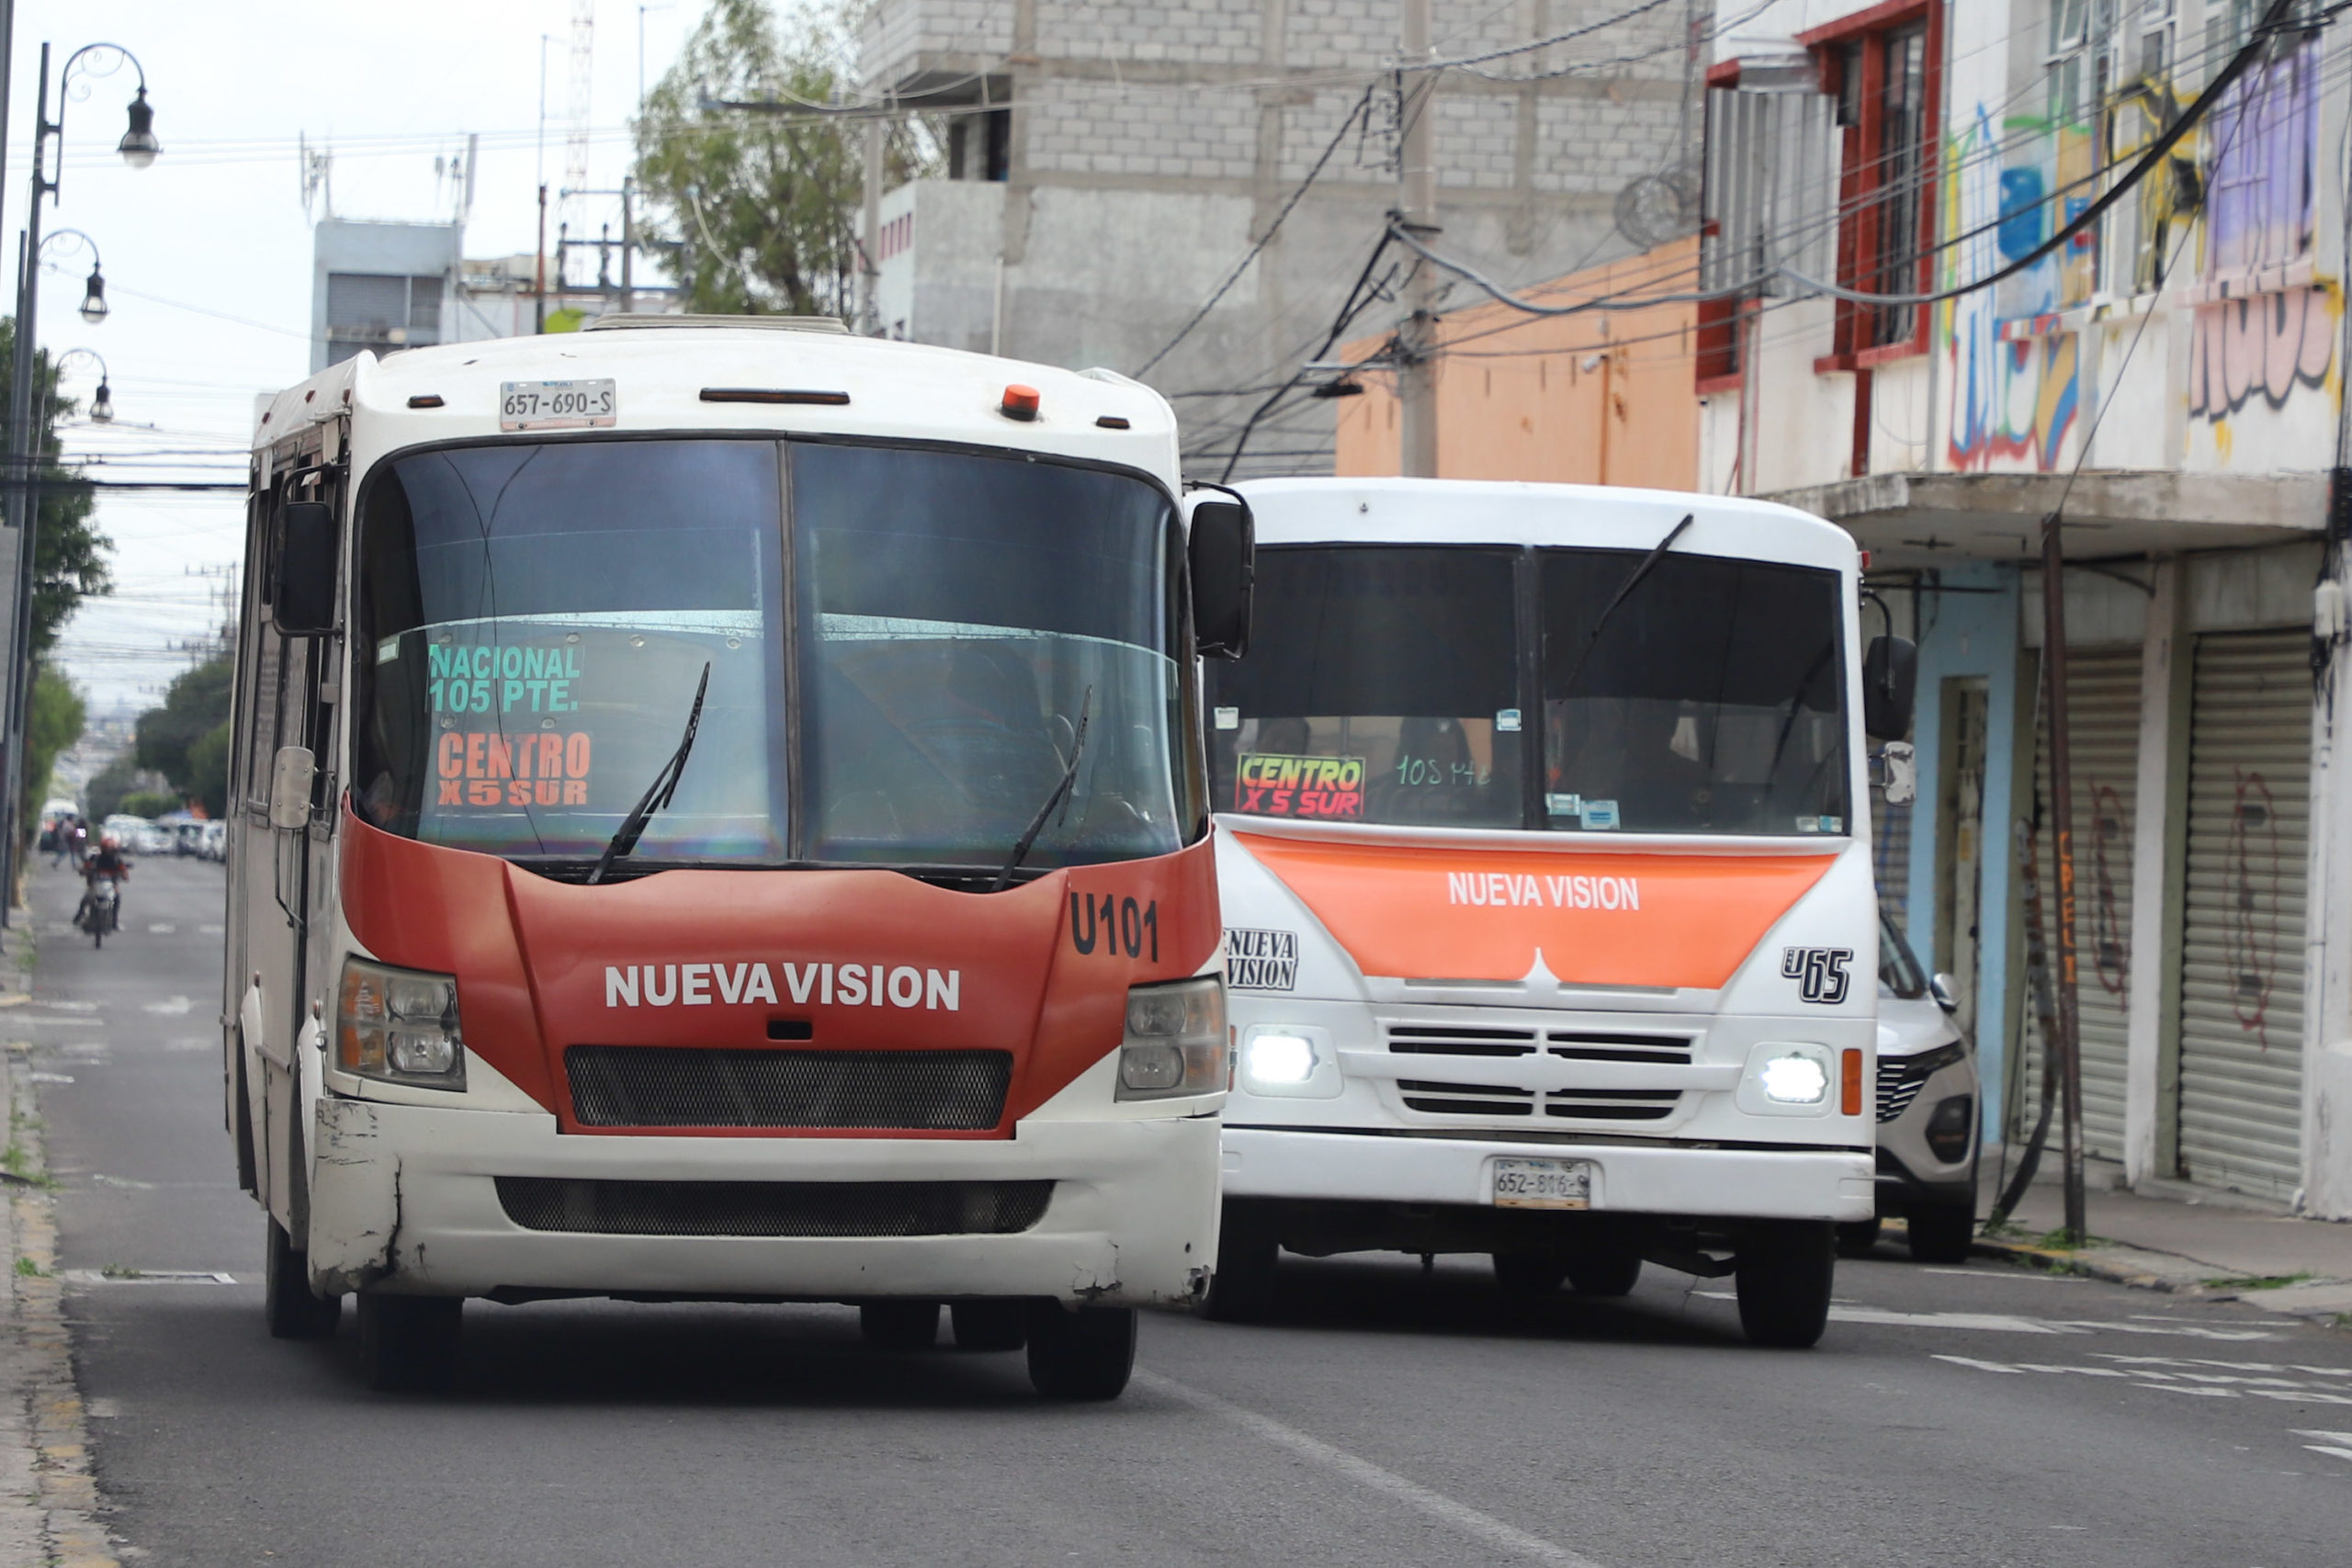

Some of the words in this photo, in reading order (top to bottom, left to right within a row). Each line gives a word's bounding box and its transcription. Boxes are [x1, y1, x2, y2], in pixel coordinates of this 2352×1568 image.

[504, 390, 612, 415] 657-690-S
[429, 644, 581, 679] NACIONAL
[428, 679, 491, 713] 105
[503, 680, 579, 713] PTE.
[437, 732, 591, 780] CENTRO
[1241, 757, 1362, 792] CENTRO
[437, 781, 463, 806] X
[468, 780, 503, 807] 5
[508, 780, 588, 807] SUR
[1241, 788, 1266, 812] X
[1296, 791, 1360, 815] SUR
[1448, 872, 1544, 907] NUEVA
[1545, 875, 1640, 910] VISION
[1070, 892, 1159, 963] U101
[1228, 930, 1294, 958] NUEVA
[605, 962, 779, 1008] NUEVA
[783, 962, 959, 1011] VISION
[1227, 958, 1294, 987] VISION
[1781, 946, 1854, 1005] U65
